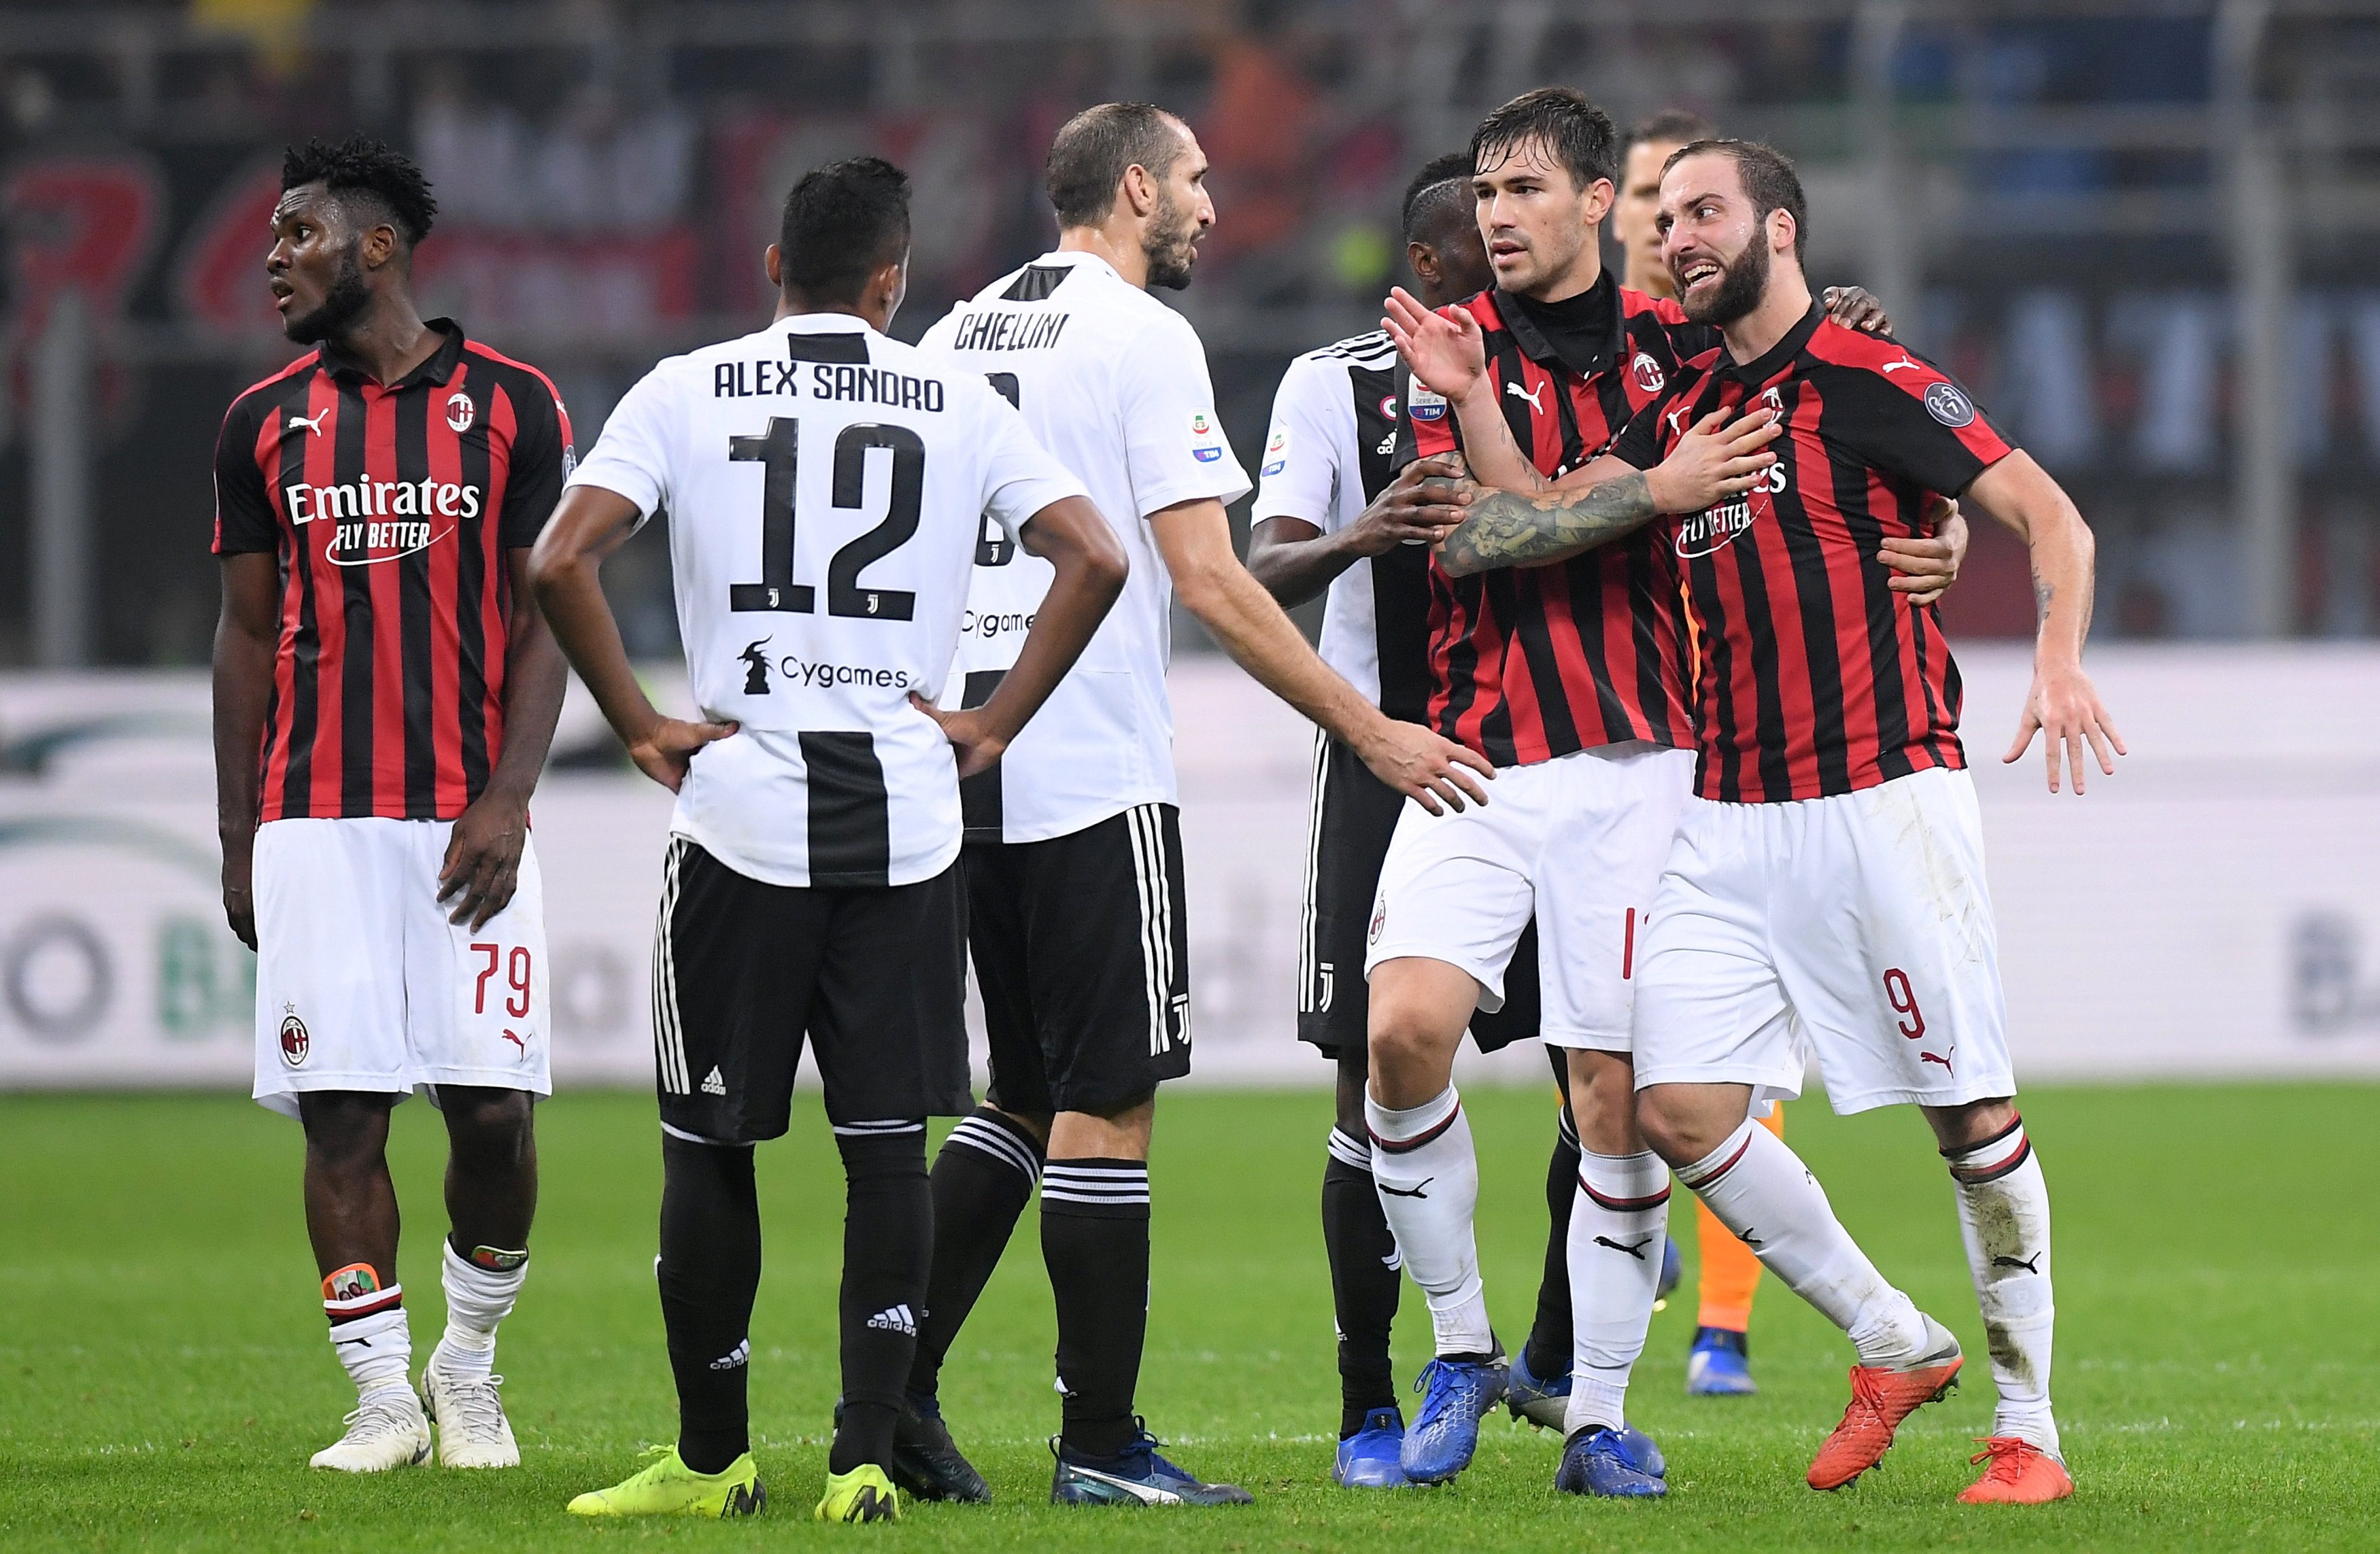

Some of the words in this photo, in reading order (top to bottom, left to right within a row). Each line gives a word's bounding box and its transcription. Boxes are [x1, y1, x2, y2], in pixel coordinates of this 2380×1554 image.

[954, 312, 1070, 351] CHIELLINI
[715, 361, 798, 398] ALEX
[813, 366, 945, 413] SANDRO
[1424, 408, 1440, 416] TIM
[286, 473, 480, 525] Emirates
[729, 416, 925, 621] 12
[335, 523, 363, 551] FLY
[367, 522, 430, 549] BETTER
[1682, 513, 1705, 545] FLY
[1705, 502, 1751, 537] BETTER
[962, 610, 1036, 639] Cygame
[781, 655, 908, 689] Cygames
[470, 944, 531, 1018] 79
[1882, 967, 1926, 1039] 9
[867, 1317, 917, 1337] adidas
